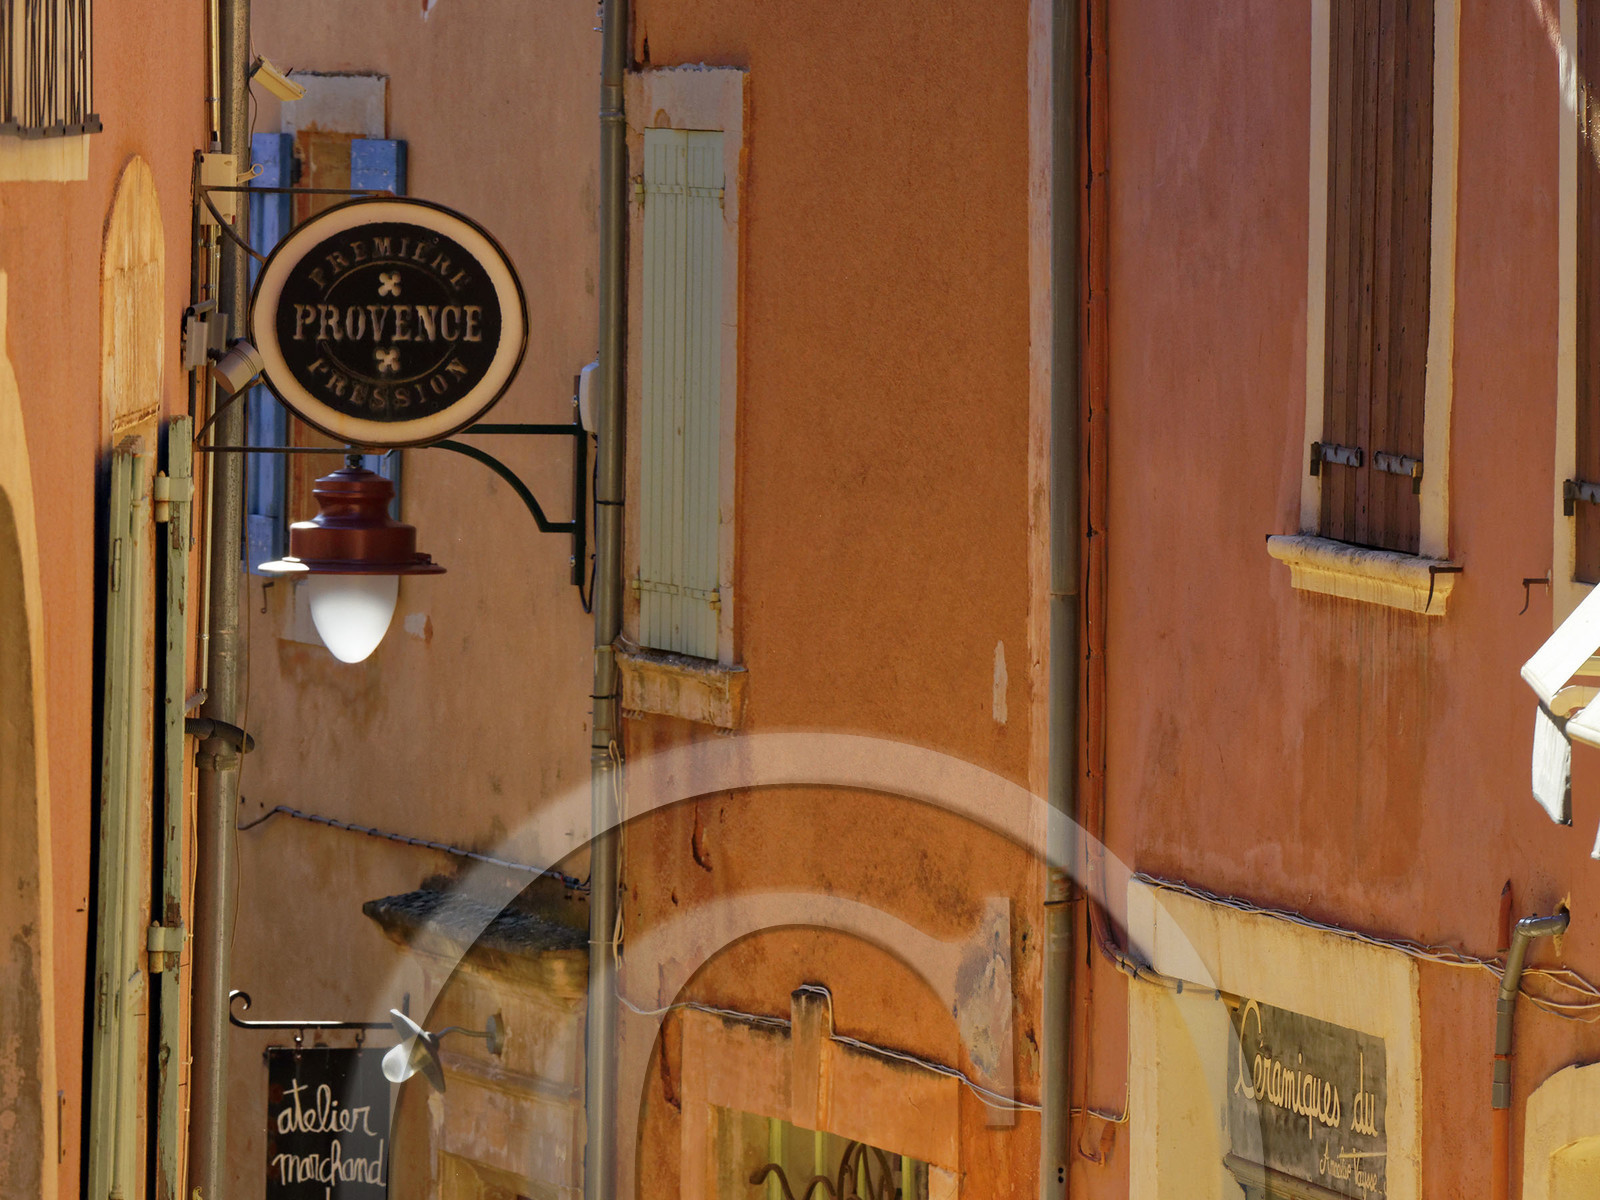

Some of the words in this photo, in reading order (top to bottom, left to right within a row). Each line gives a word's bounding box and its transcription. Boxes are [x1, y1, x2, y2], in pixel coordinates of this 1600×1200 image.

[292, 303, 483, 342] PROVENCE
[307, 356, 468, 409] PRESSION
[277, 1078, 378, 1135] atelier
[1351, 1052, 1378, 1137] du
[271, 1139, 386, 1187] marchand
